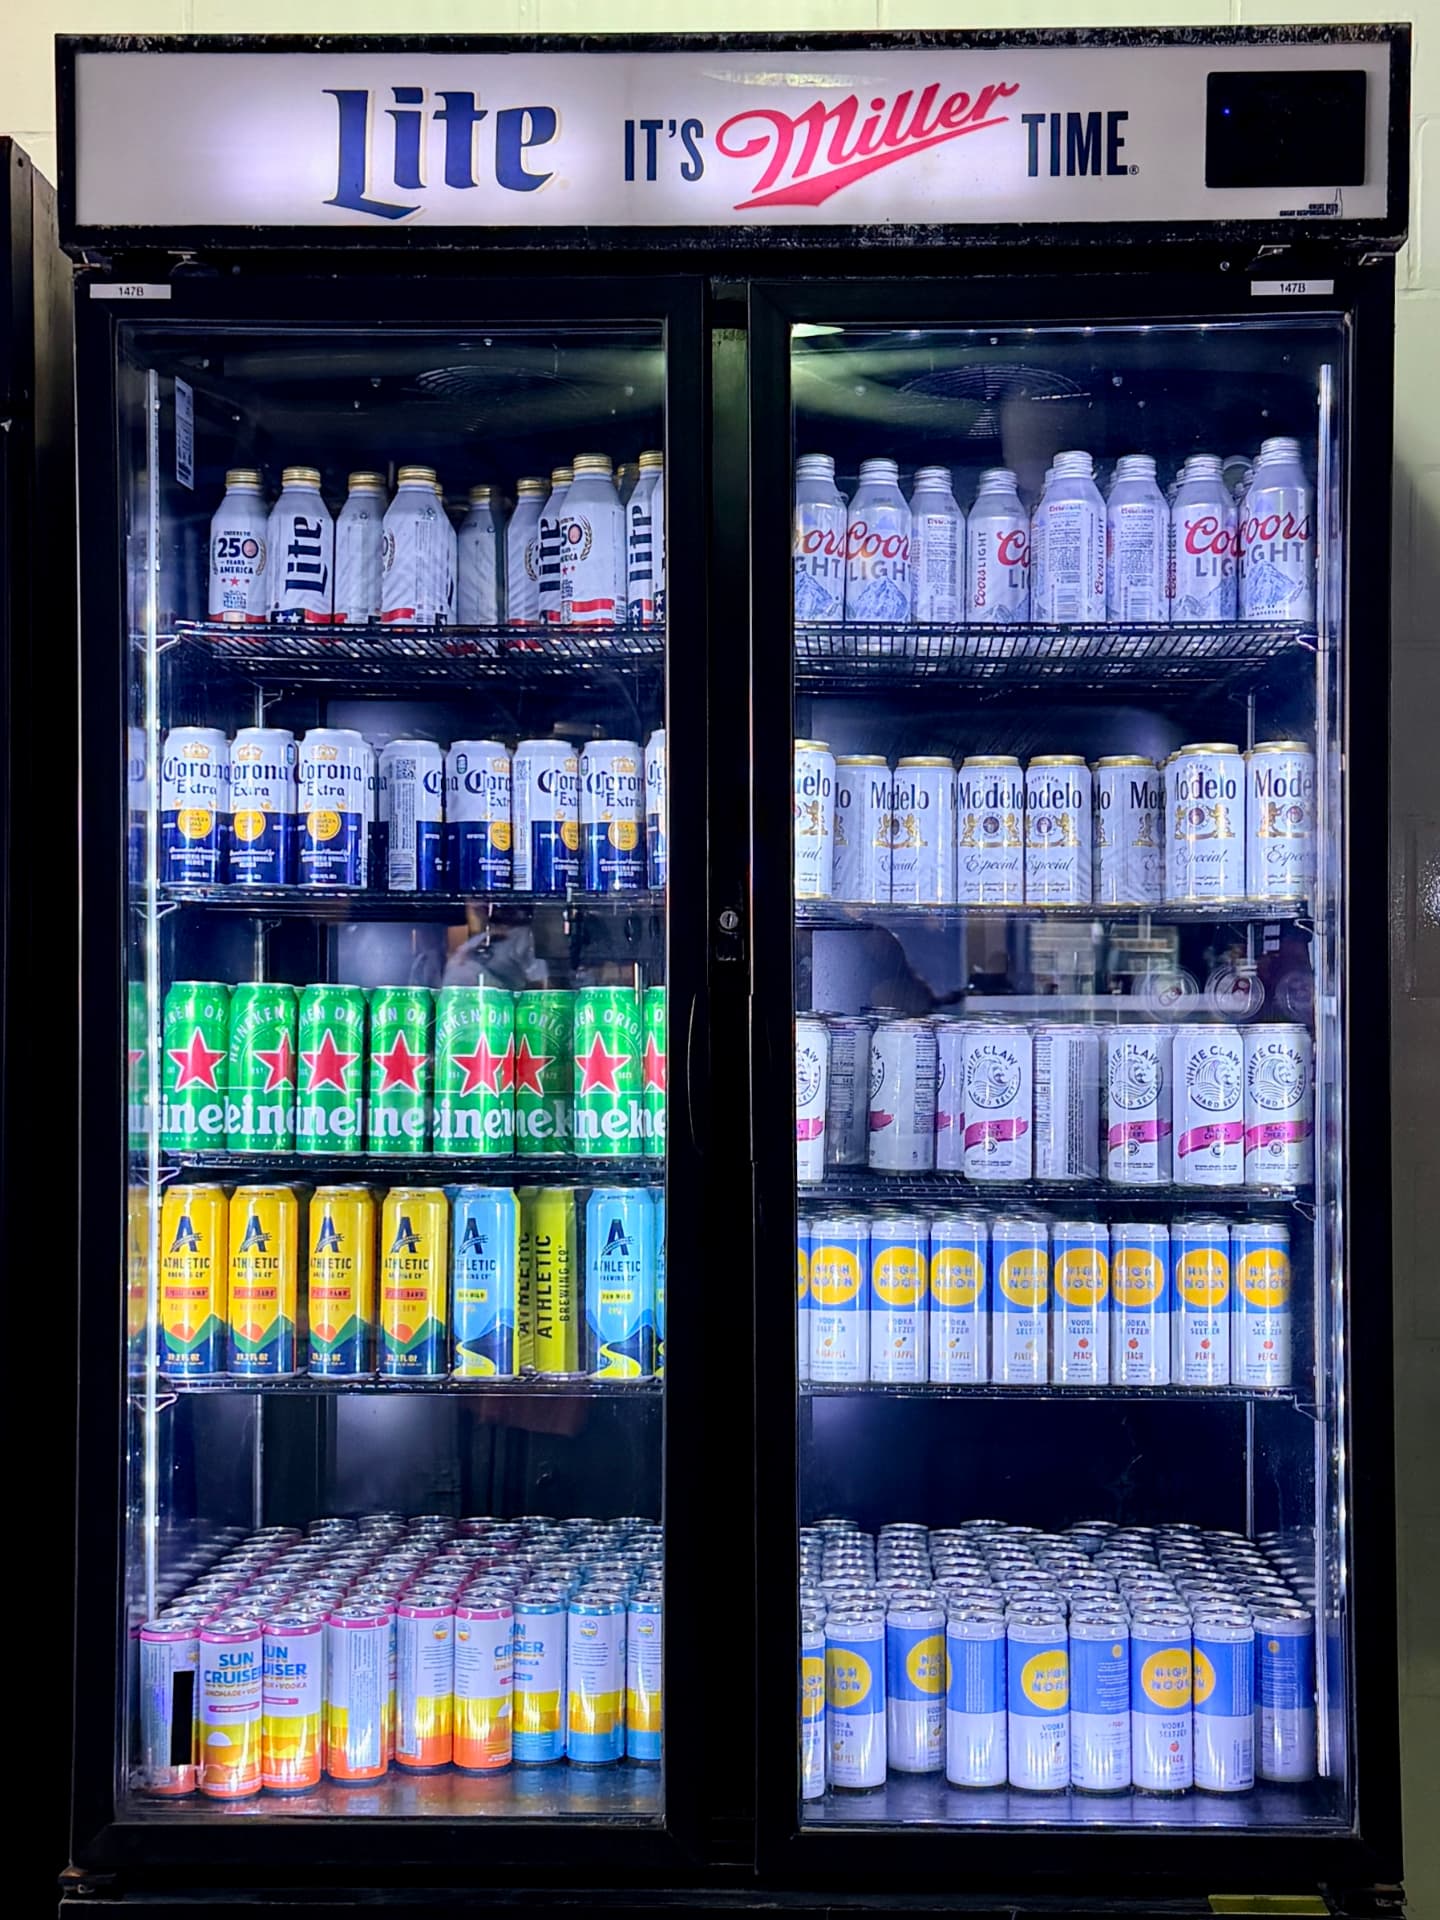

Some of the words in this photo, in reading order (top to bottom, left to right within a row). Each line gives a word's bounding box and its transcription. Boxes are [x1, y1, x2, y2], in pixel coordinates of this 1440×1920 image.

[321, 85, 559, 219] Lite
[624, 118, 704, 182] IT'S
[715, 82, 1019, 209] Miller
[119, 286, 145, 297] 147B
[1280, 283, 1306, 293] 147B
[217, 537, 259, 559] 250
[285, 516, 328, 597] Lite
[978, 532, 988, 569] LIGHT
[220, 566, 254, 574] AMERICA
[959, 782, 1024, 810] Modelo
[983, 1045, 1019, 1066] CLAW
[1186, 1048, 1208, 1087] WHITE
[1209, 1045, 1240, 1066] CLAW
[1247, 1048, 1266, 1086] WHITE
[1267, 1044, 1304, 1065] CLAW
[535, 1234, 553, 1340] ATHLETIC
[559, 1268, 571, 1322] BREWING
[219, 1651, 254, 1668] SUN
